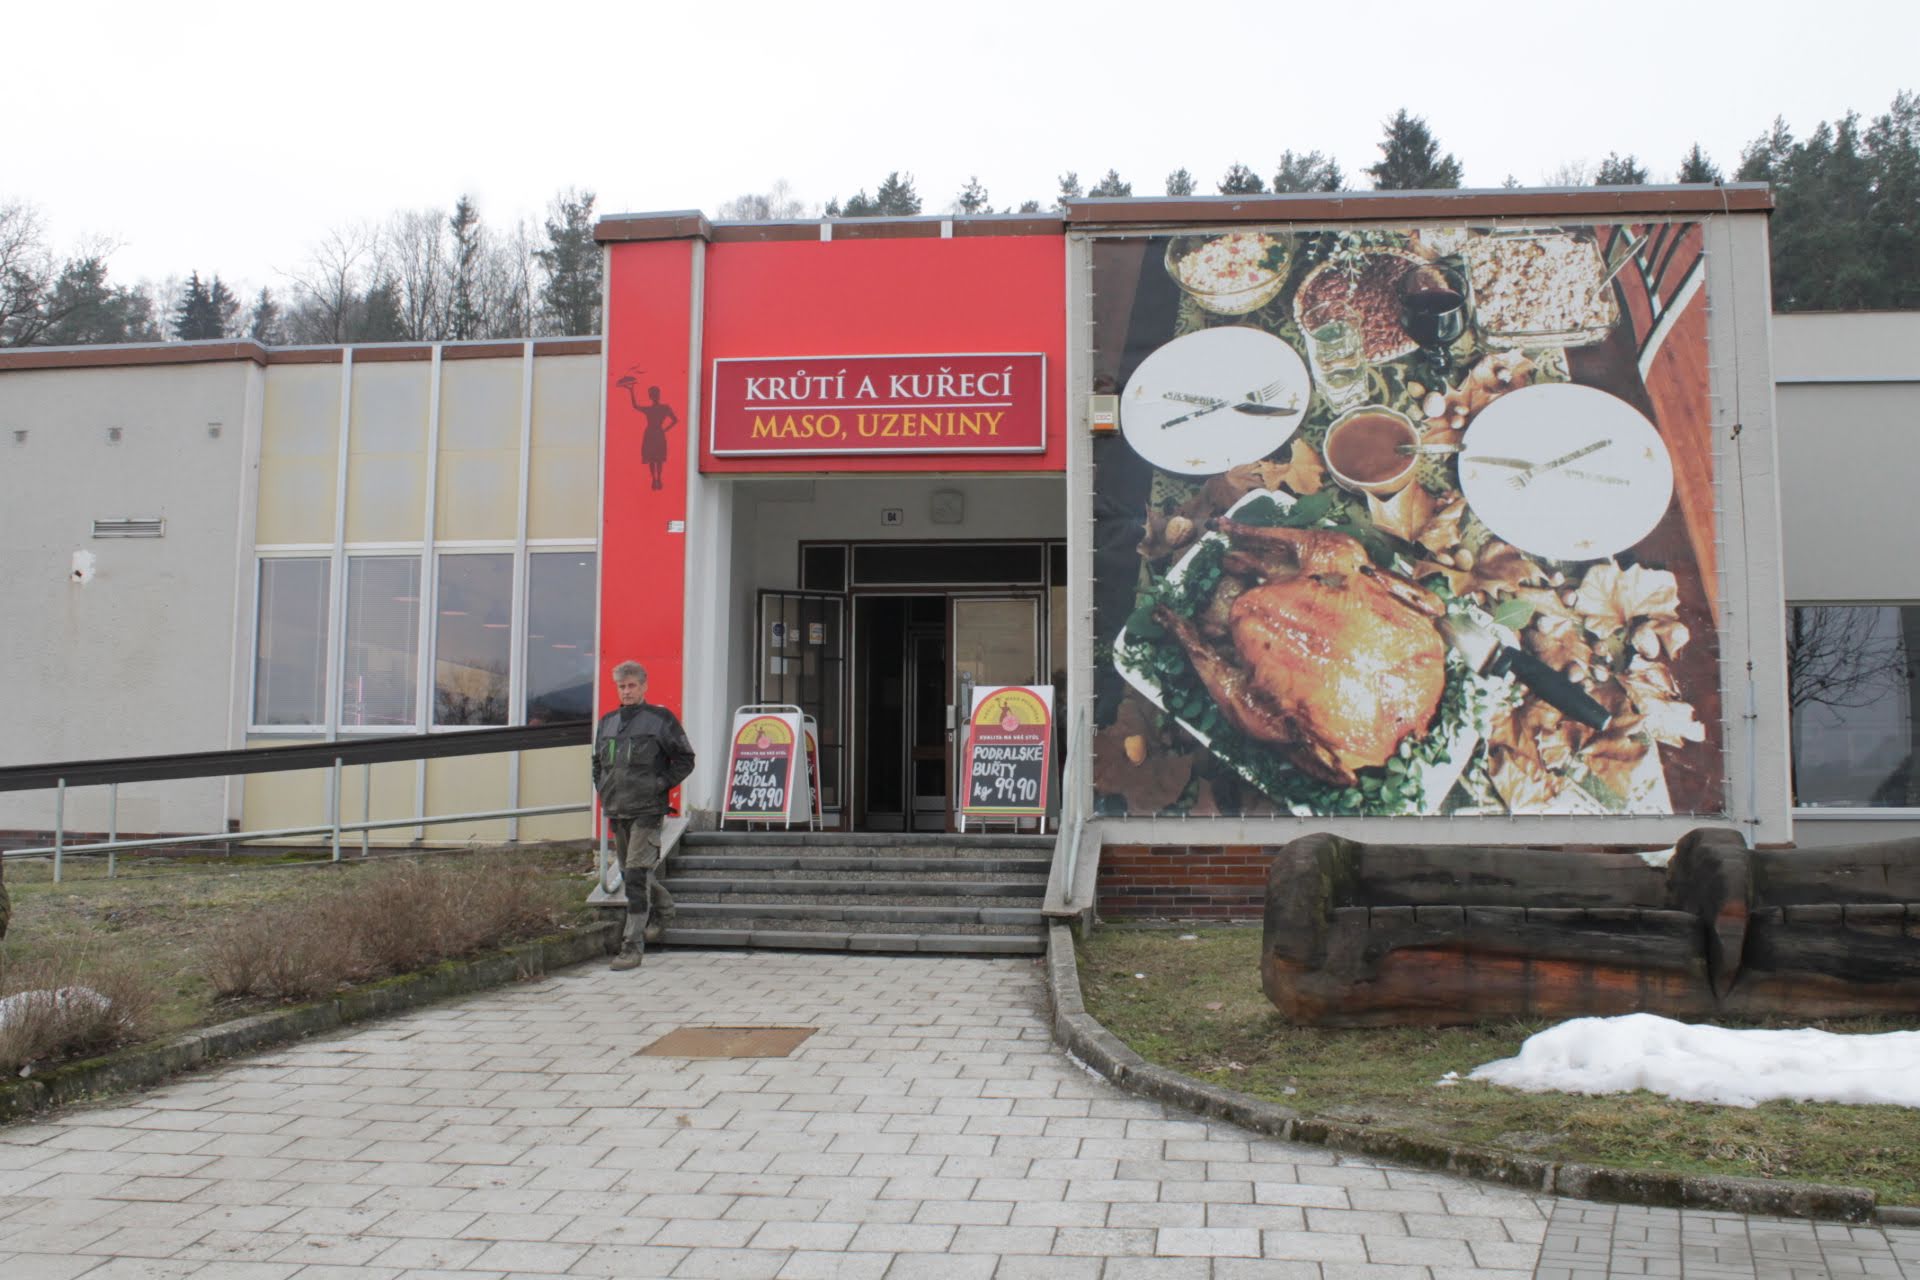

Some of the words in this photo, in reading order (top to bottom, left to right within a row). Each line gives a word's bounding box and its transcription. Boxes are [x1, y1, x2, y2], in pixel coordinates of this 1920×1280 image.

[745, 369, 847, 401] KRŮTÍ
[855, 379, 879, 399] A
[888, 366, 1013, 399] KUŘECÍ
[751, 414, 848, 440] MASO,
[857, 412, 1005, 438] UZENINY
[973, 741, 1044, 761] PODRALSKÉ
[735, 757, 776, 773] KRŮTÍ
[972, 761, 1017, 778] BUŘTY
[732, 771, 777, 787] KŘÍDLA
[995, 777, 1037, 802] 99,90
[747, 788, 784, 811] 59,90
